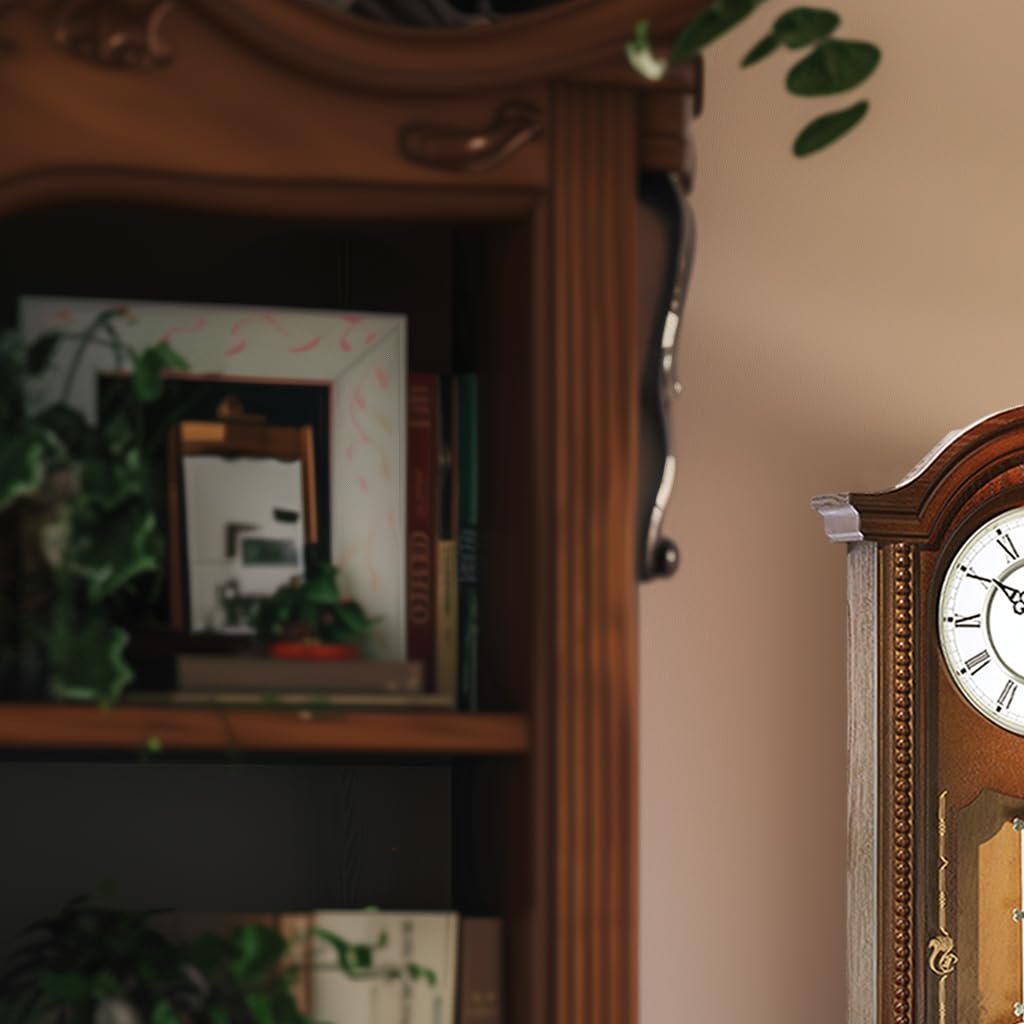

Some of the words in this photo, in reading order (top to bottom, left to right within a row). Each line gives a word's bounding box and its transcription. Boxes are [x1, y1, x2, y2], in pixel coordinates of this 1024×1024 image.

[996, 534, 1020, 564] XI
[966, 567, 992, 590] X
[954, 614, 981, 628] IX
[964, 649, 991, 676] VIII
[997, 679, 1018, 709] VII
